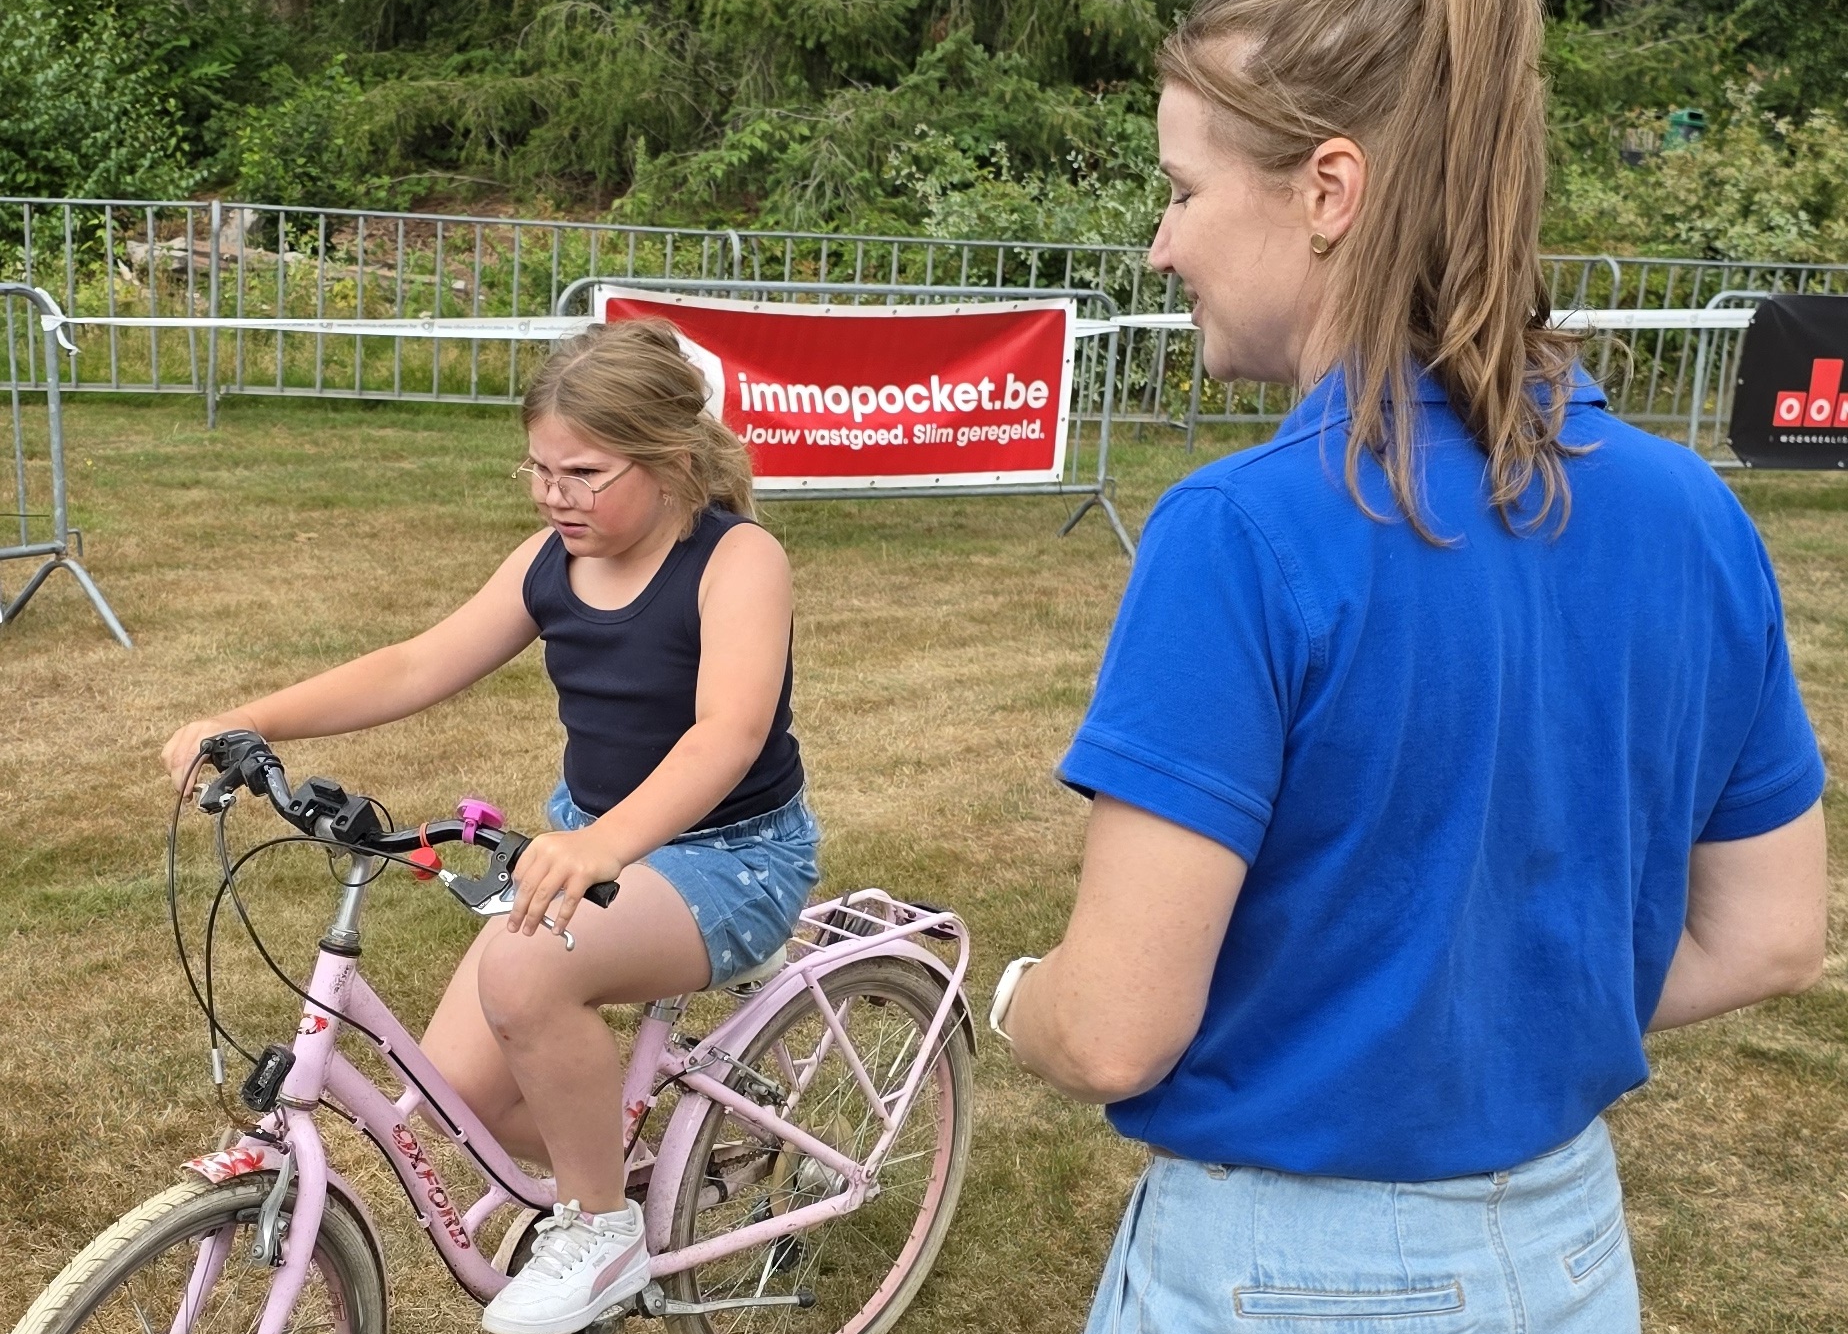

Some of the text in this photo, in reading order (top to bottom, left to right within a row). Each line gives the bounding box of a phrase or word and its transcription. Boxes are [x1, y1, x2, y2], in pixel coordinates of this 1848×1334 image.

[738, 372, 1049, 422] immopocket.be
[738, 418, 1045, 450] Jouw vastgoed. Slim geregeld.
[392, 1123, 471, 1249] OXFORD
